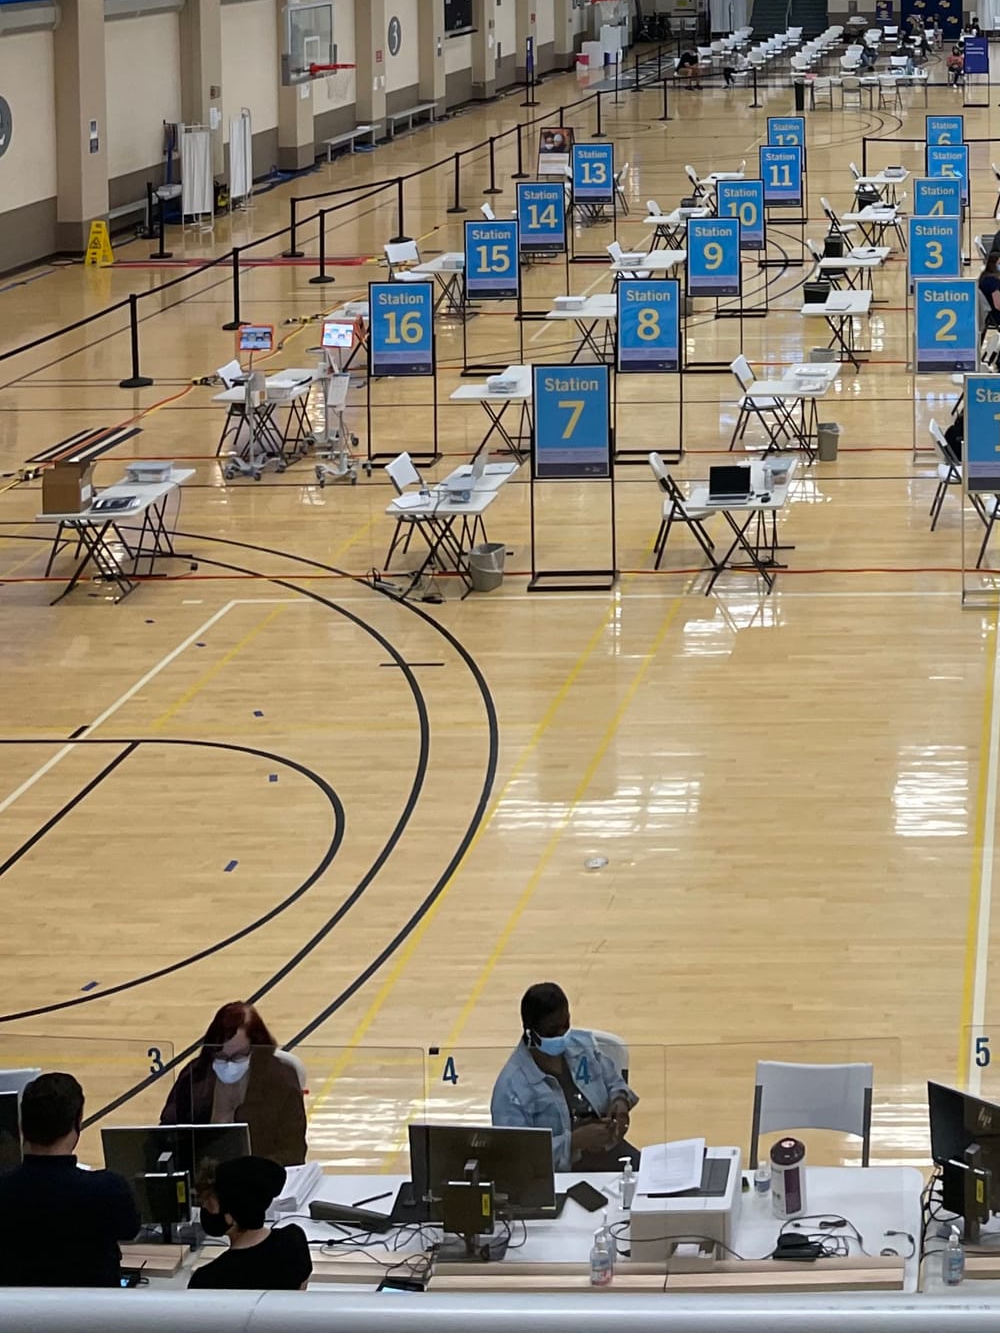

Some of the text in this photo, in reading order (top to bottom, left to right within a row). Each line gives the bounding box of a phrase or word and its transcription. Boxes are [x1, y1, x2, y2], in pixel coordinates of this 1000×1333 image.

[391, 21, 398, 53] 3
[932, 122, 958, 130] Station
[938, 133, 951, 144] 6
[579, 150, 608, 159] Station
[765, 152, 796, 161] Station
[932, 151, 963, 160] Station
[581, 162, 606, 184] 13
[769, 164, 793, 187] 11
[940, 164, 954, 178] 5
[524, 191, 559, 200] Station
[724, 188, 758, 198] Station
[921, 186, 954, 195] Station
[728, 202, 757, 227] 10
[928, 200, 944, 215] 4
[527, 204, 559, 229] 14
[472, 229, 511, 240] Station
[695, 226, 732, 237] Station
[915, 225, 953, 236] Station
[476, 245, 510, 273] 15
[703, 242, 723, 270] 9
[924, 241, 944, 269] 3
[378, 293, 424, 305] Station
[626, 289, 671, 302] Station
[924, 290, 969, 302] Station
[383, 311, 424, 344] 16
[636, 308, 661, 341] 8
[935, 308, 958, 342] 2
[544, 377, 599, 392] Station
[558, 400, 586, 439] 7
[976, 1037, 990, 1067] 5
[147, 1047, 164, 1075] 3
[442, 1056, 459, 1085] 4
[575, 1056, 591, 1085] 4
